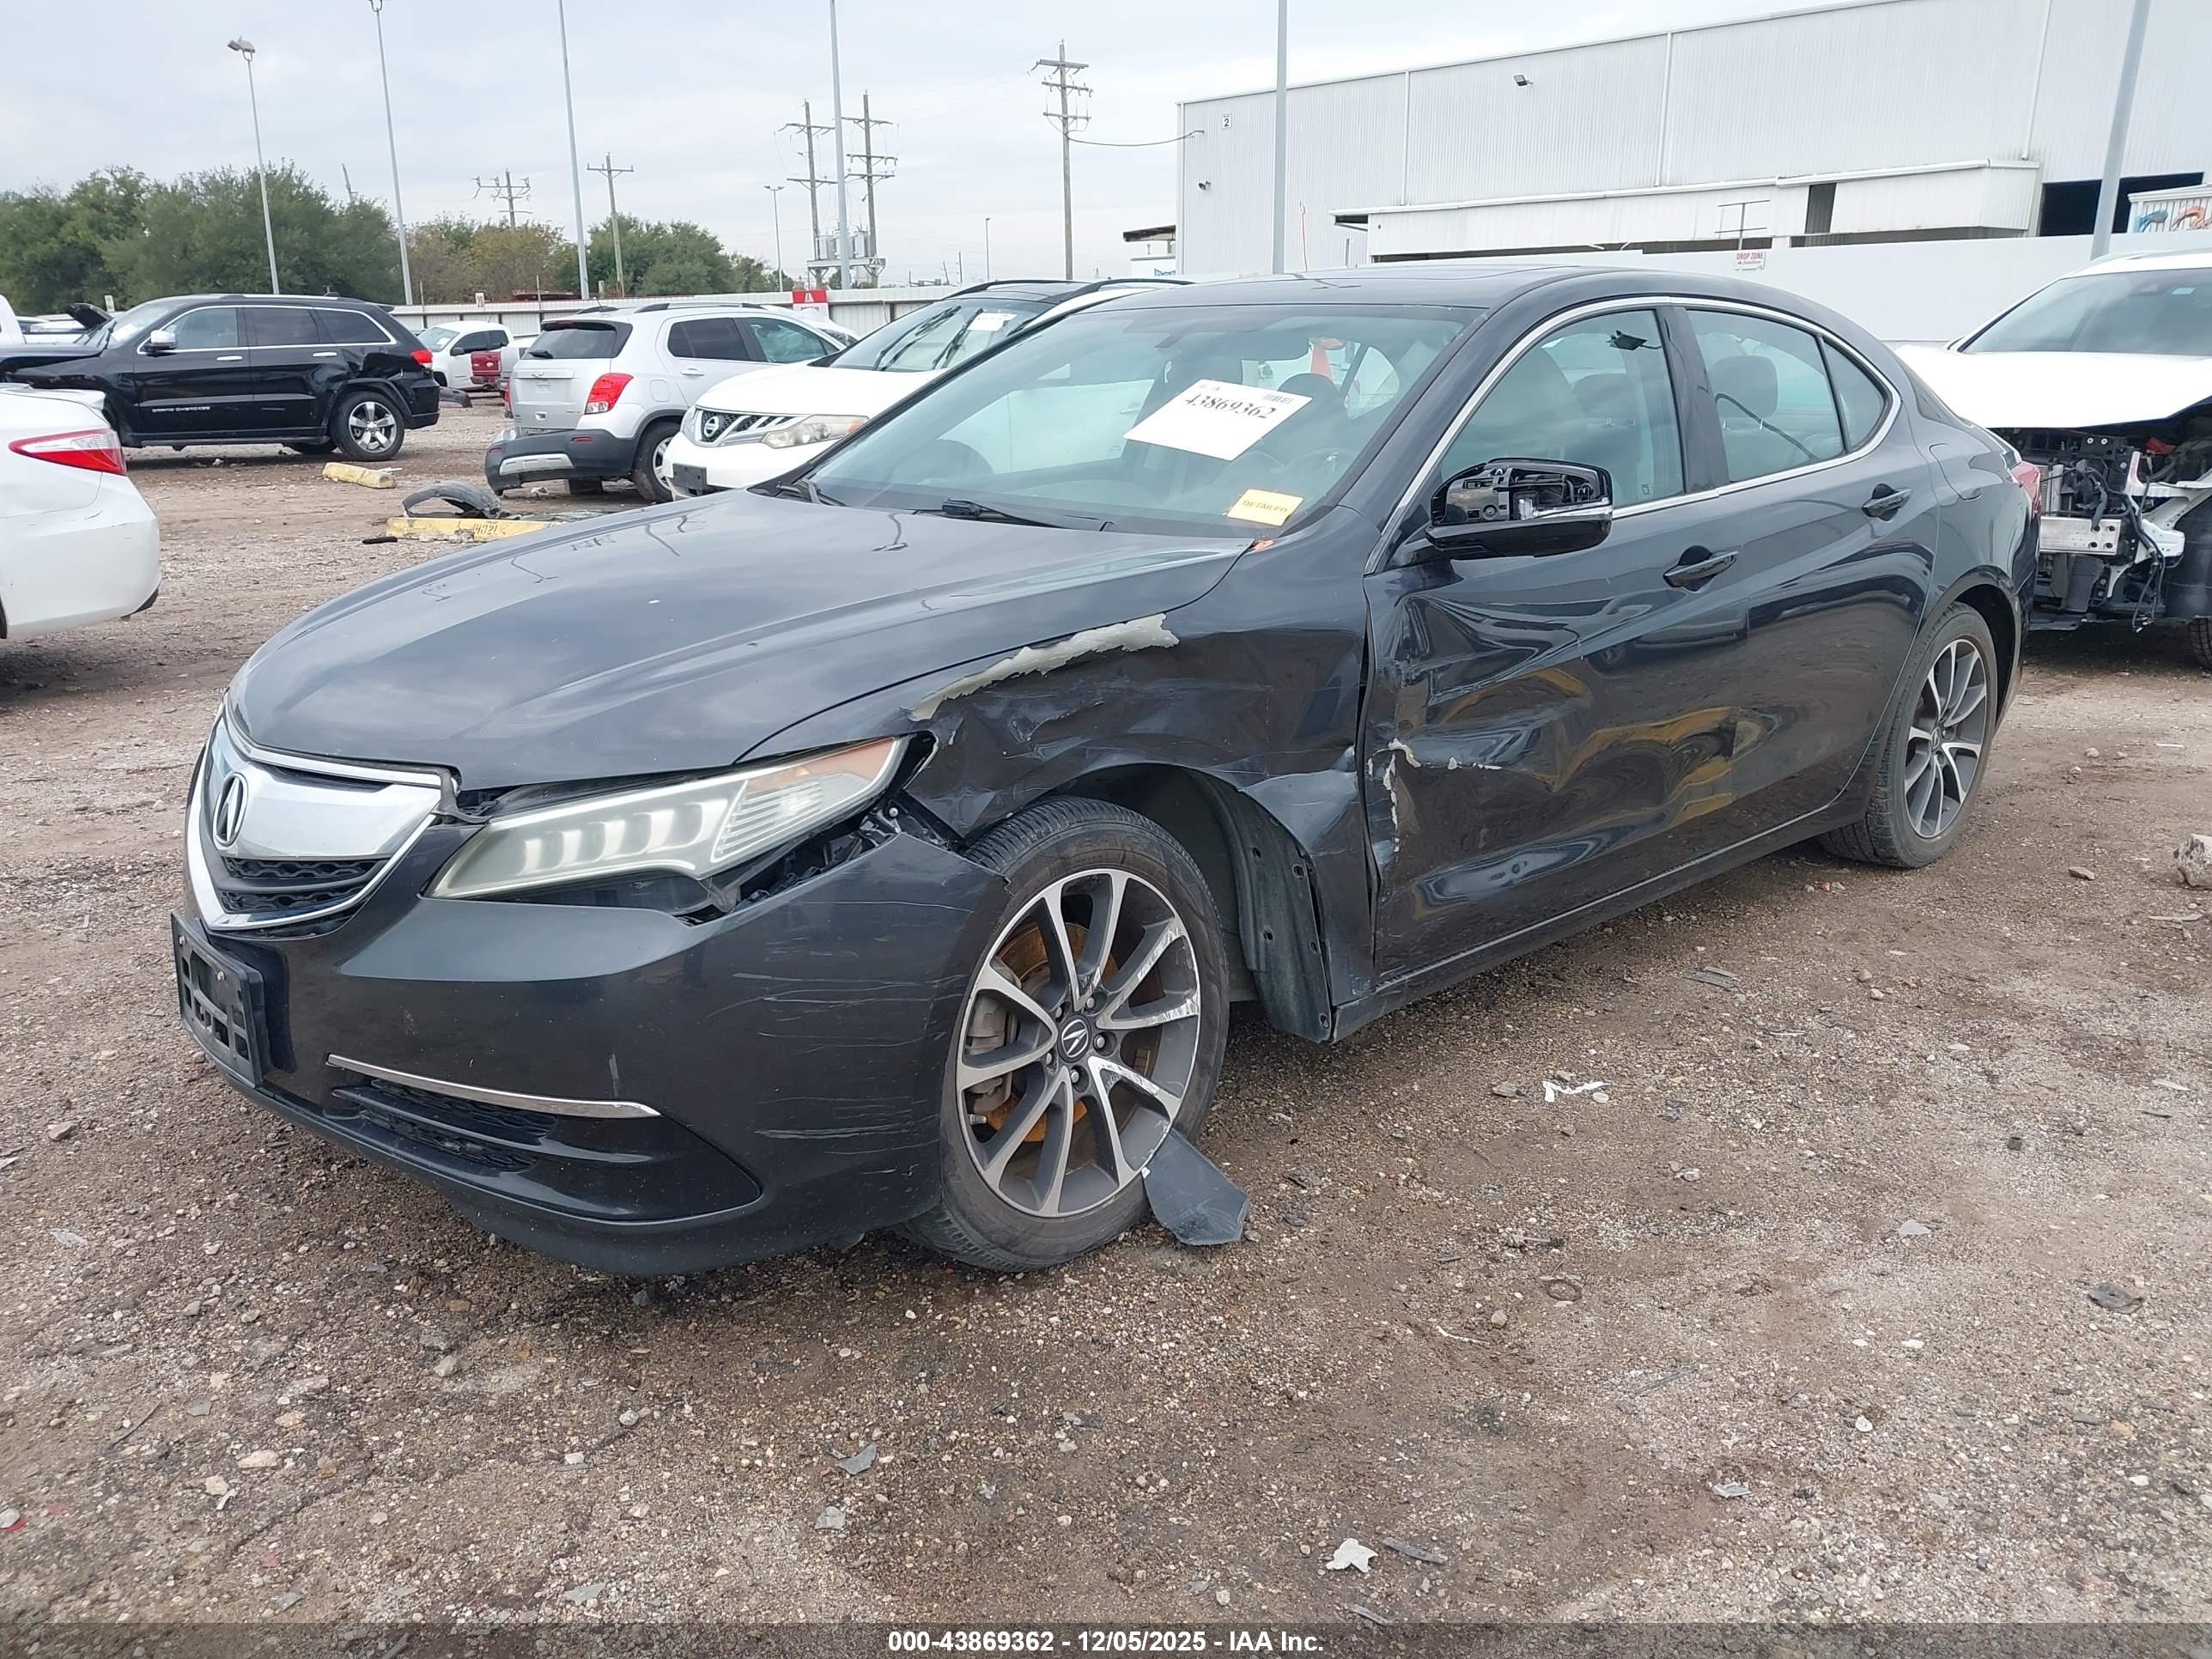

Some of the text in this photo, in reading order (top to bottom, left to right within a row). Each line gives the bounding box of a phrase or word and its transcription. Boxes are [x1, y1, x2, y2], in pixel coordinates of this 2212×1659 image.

[1224, 118, 1230, 127] 2
[1185, 392, 1277, 419] 43869362
[1242, 500, 1288, 513] DETAILED
